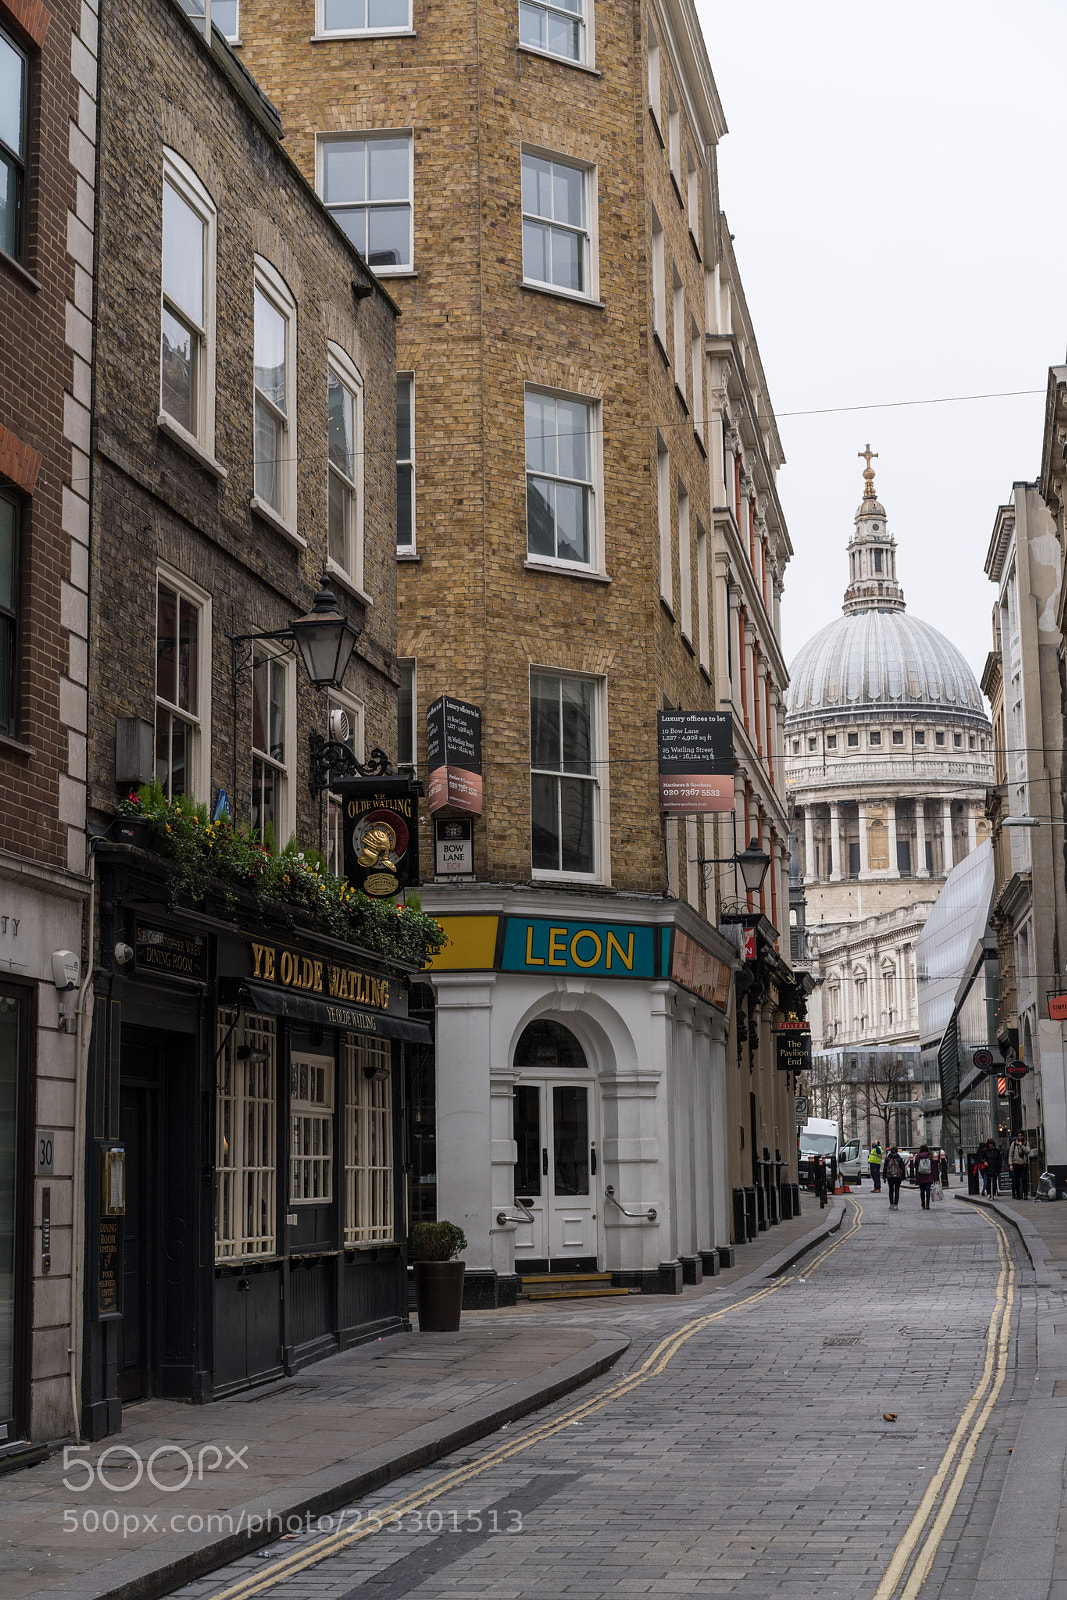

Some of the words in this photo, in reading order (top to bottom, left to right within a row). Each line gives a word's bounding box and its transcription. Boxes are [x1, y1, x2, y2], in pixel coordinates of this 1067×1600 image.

[348, 800, 372, 818] OLDE
[372, 798, 412, 818] WATLING
[525, 925, 635, 970] LEON
[146, 946, 171, 967] DINING
[172, 954, 193, 972] ROOM
[252, 942, 275, 981] YE
[280, 951, 323, 992] OLDE
[326, 964, 390, 1010] WATLING
[326, 1006, 336, 1022] YE
[336, 1009, 351, 1025] OLDE
[351, 1011, 377, 1030] WATLING
[40, 1140, 52, 1165] 30
[100, 1223, 117, 1233] DINING
[101, 1234, 116, 1245] ROOM
[100, 1280, 115, 1288] SERVED
[102, 1271, 114, 1279] FOOD
[102, 1288, 114, 1296] UNTIL
